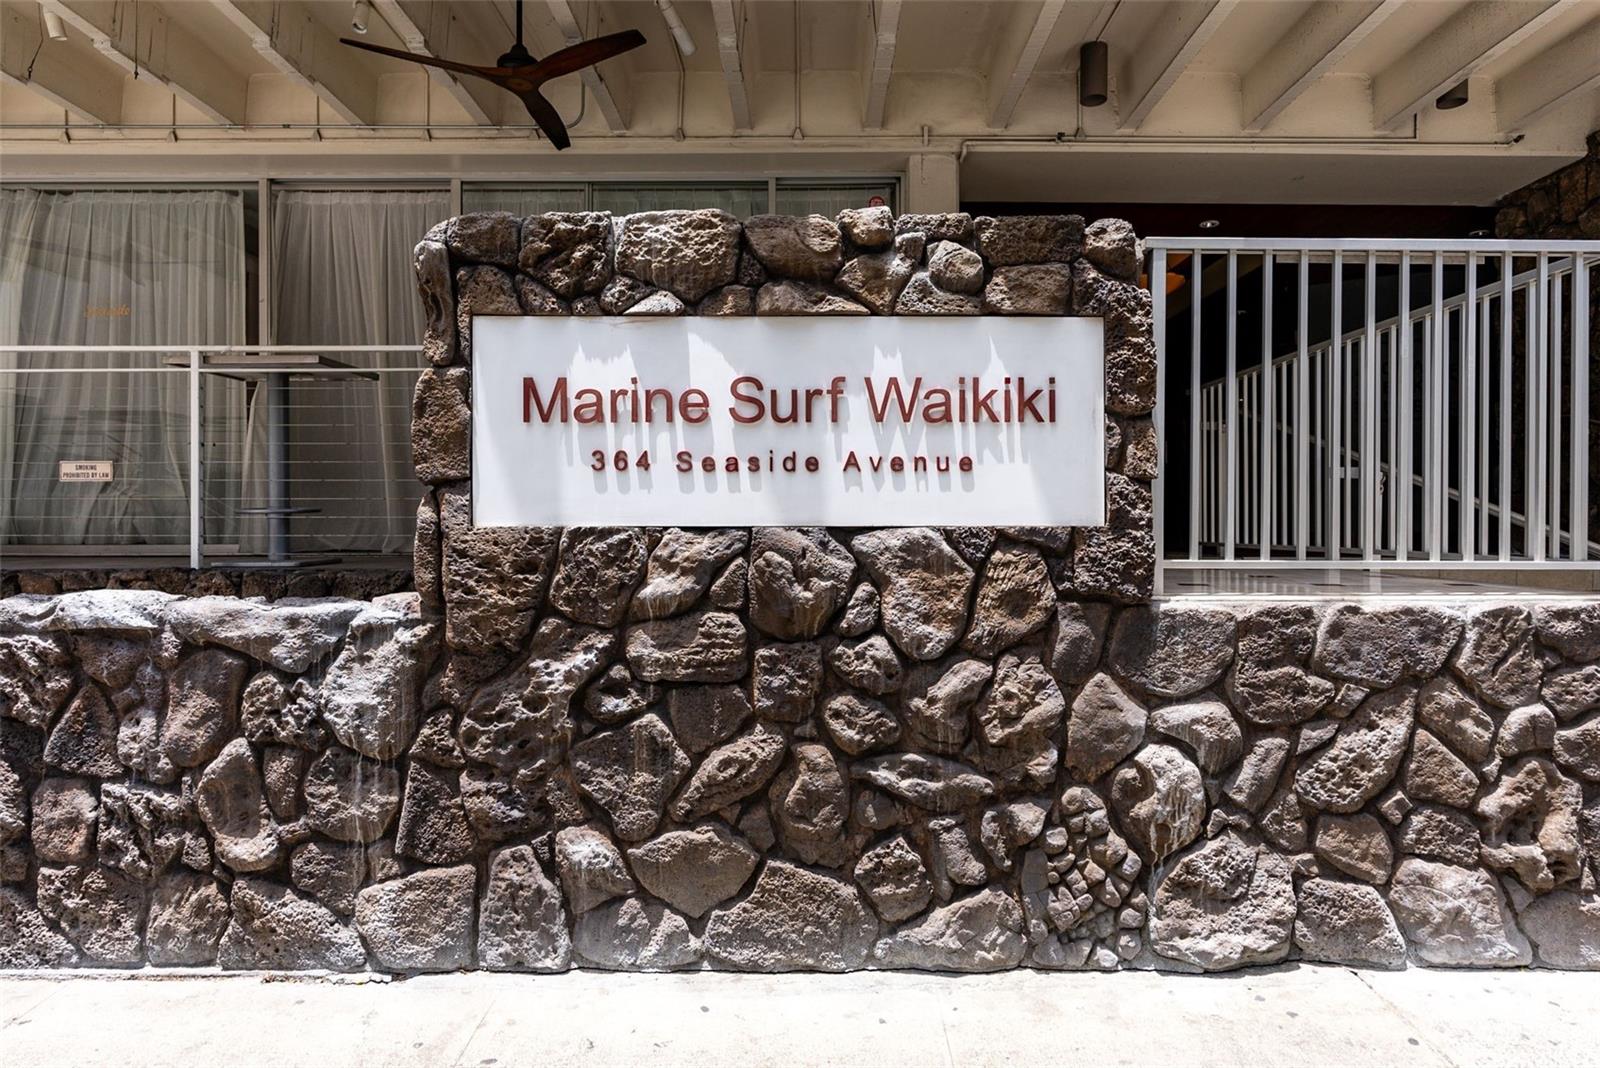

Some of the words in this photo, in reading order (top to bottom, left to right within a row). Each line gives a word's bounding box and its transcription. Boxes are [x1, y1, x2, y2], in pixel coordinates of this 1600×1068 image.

[522, 376, 710, 424] Marine
[730, 375, 846, 424] Surf
[864, 376, 1057, 424] Waikiki
[591, 449, 652, 473] 364
[676, 449, 820, 474] Seaside
[843, 449, 975, 473] Avenue
